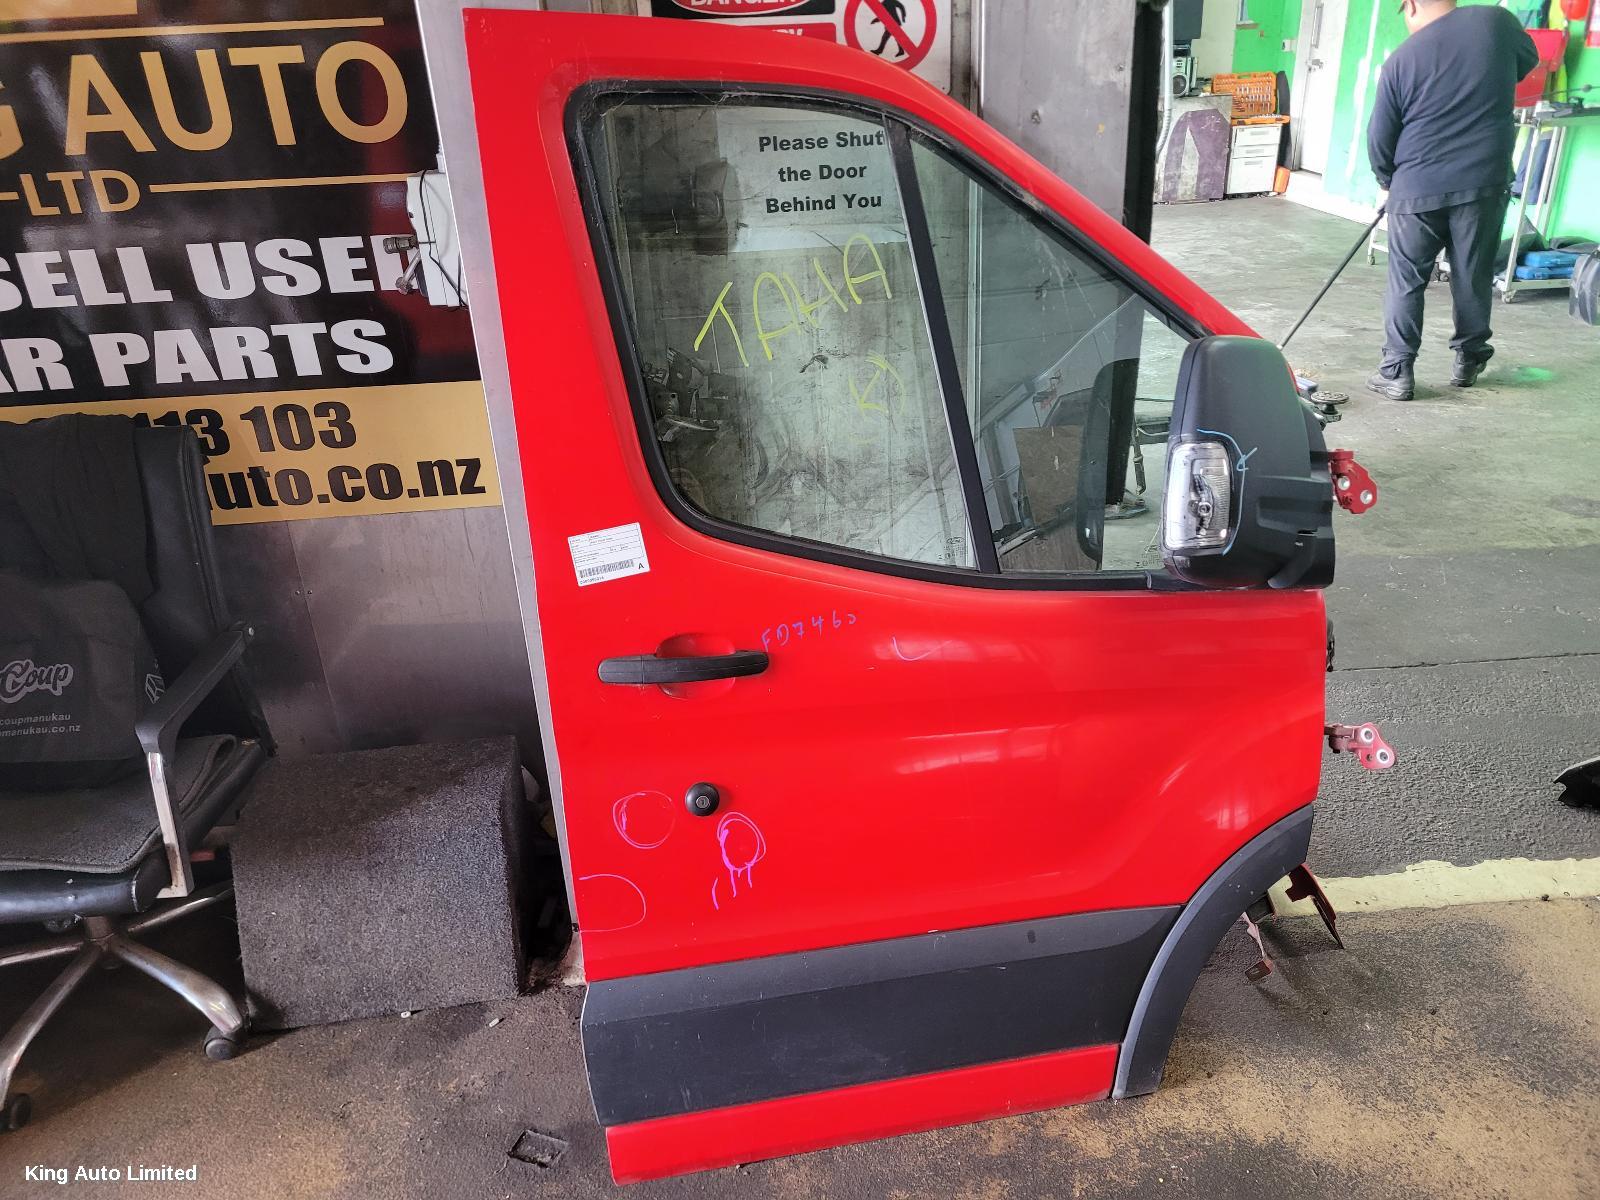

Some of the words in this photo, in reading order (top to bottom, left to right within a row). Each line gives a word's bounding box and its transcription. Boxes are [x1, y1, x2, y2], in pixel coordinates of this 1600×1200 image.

[65, 40, 408, 156] AUTO
[758, 136, 829, 152] Please
[836, 130, 884, 148] Shut
[19, 169, 140, 216] LTD
[778, 166, 812, 182] the
[819, 164, 867, 180] Door
[765, 194, 836, 213] Behind
[843, 193, 882, 209] You
[694, 233, 892, 368] TAHA
[89, 318, 394, 387] PARTS
[240, 400, 357, 453] 103
[207, 457, 486, 511] uto.co.nz
[0, 725, 81, 737] manukau.co.nz
